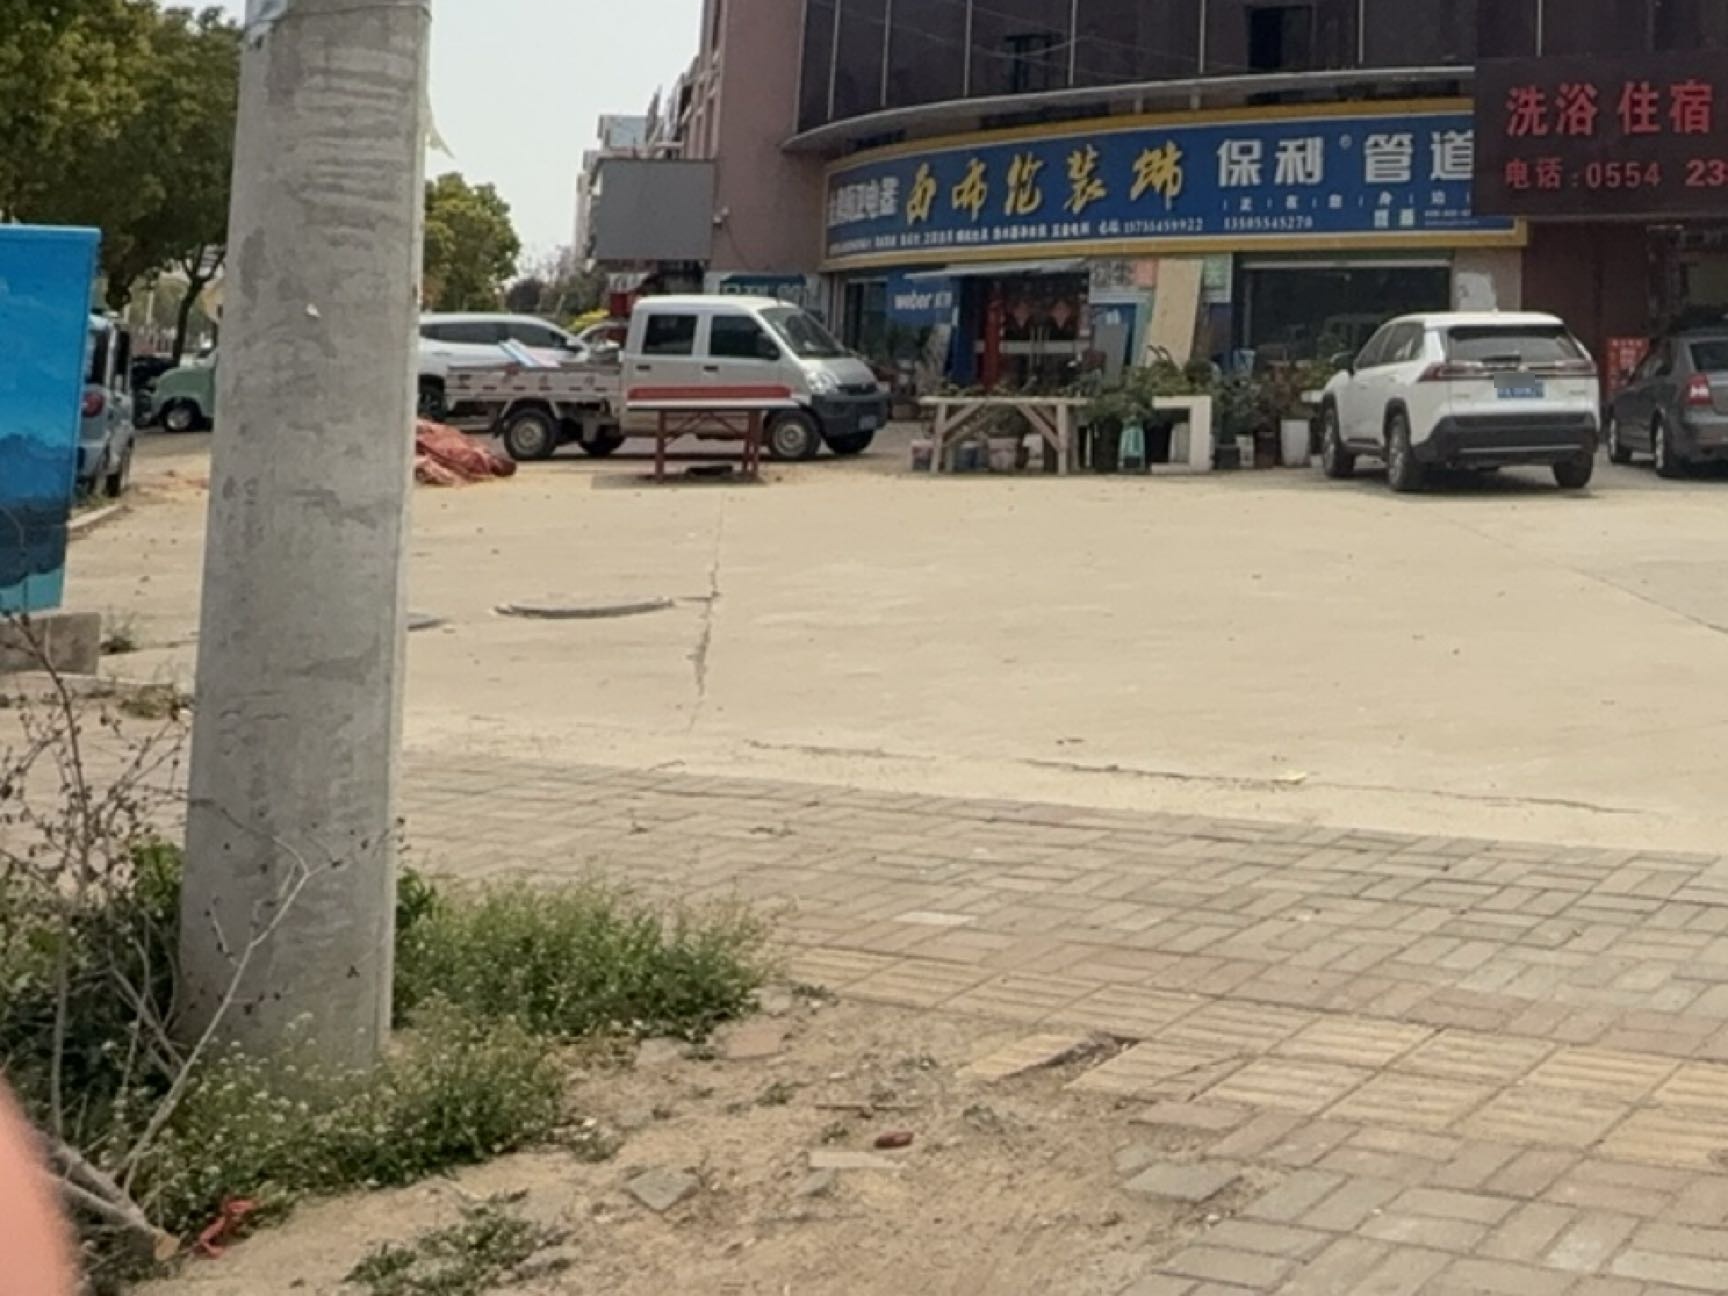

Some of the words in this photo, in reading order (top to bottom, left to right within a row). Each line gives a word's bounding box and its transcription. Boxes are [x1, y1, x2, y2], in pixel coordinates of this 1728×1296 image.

[1504, 83, 1598, 136] 洗浴
[1617, 79, 1713, 133] 住宿
[1217, 135, 1324, 188] 保利
[1363, 129, 1474, 184] 管道
